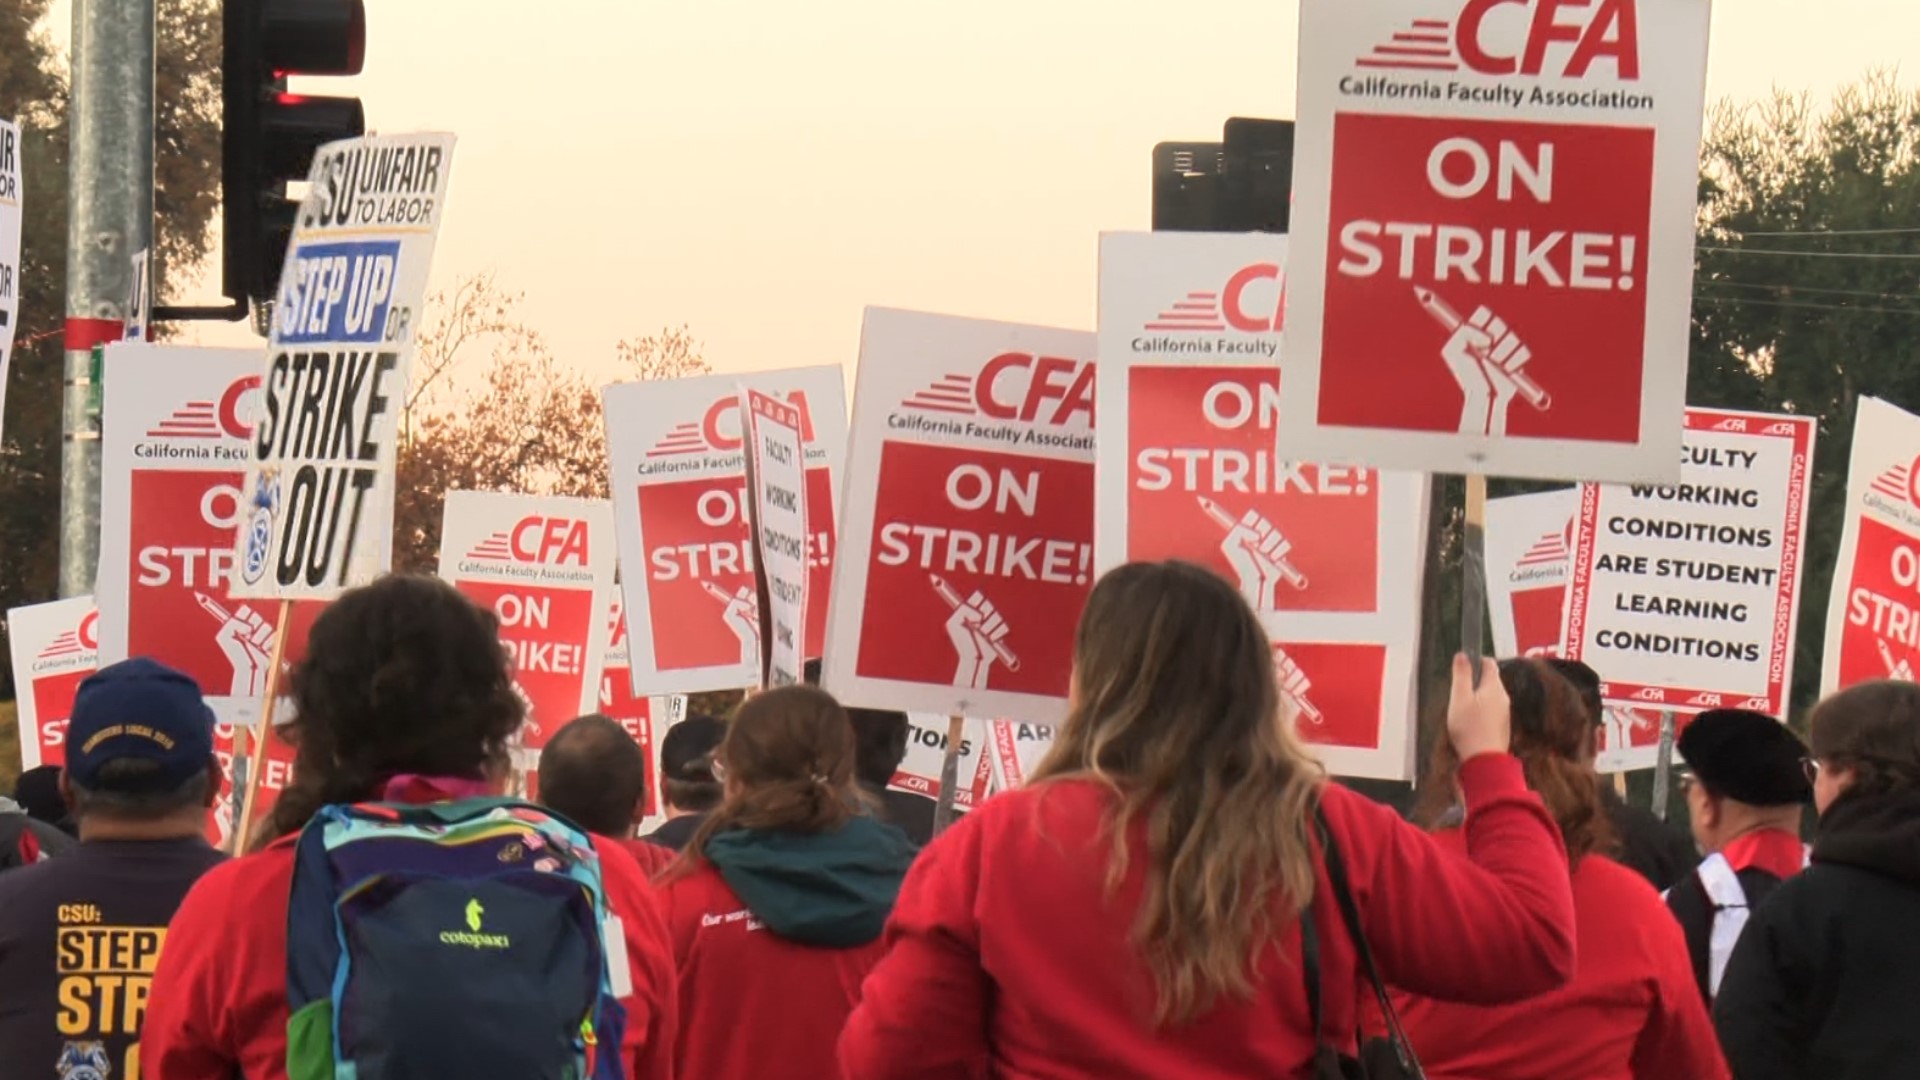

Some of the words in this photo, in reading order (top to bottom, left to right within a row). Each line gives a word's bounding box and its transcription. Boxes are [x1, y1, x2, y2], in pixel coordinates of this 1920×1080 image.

[1455, 0, 1640, 81] CFA
[1339, 76, 1441, 99] California
[1447, 82, 1524, 108] Faculty
[1529, 86, 1655, 110] Association
[360, 145, 443, 194] UNFAIR
[1426, 136, 1555, 204] ON
[354, 199, 376, 224] TO
[377, 198, 434, 225] LABOR
[1337, 219, 1637, 292] STRIKE!
[282, 255, 348, 336] STEP
[344, 254, 394, 335] UP
[1131, 337, 1212, 354] California
[1217, 339, 1277, 358] Faculty
[257, 351, 398, 462] STRIKE
[975, 352, 1097, 429] CFA
[888, 413, 962, 435] California
[965, 422, 1022, 444] Faculty
[1024, 428, 1096, 451] Associati
[1722, 418, 1747, 432] CFA
[1772, 423, 1796, 436] CFA
[134, 443, 209, 459] California
[214, 446, 249, 460] Facu
[637, 458, 700, 476] California
[703, 455, 746, 470] Facult
[1681, 445, 1758, 469] CULTY
[945, 463, 1040, 516] ON
[1630, 483, 1760, 508] WORKING
[1786, 453, 1805, 533] CALIFORNIA
[276, 464, 377, 588] OUT
[511, 515, 589, 567] CFA
[1608, 516, 1773, 548] CONDITIONS
[878, 521, 1091, 586] STRIKE!
[1575, 525, 1591, 584] FACULTY
[1595, 554, 1649, 574] ARE
[1655, 558, 1777, 586] STUDENT
[1780, 534, 1797, 593] FACULTY
[458, 561, 502, 575] California
[505, 565, 538, 579] Faculty
[540, 568, 594, 582] Association
[496, 593, 550, 629] ON
[1568, 586, 1585, 661] CALIFORNIA
[1615, 593, 1748, 623] LEARNING
[1595, 630, 1760, 662] CONDITIONS
[1770, 595, 1790, 683] ASSOCIATION
[1641, 688, 1665, 701] CFA
[1698, 692, 1722, 706] CFA
[1747, 697, 1771, 710] CFA
[908, 776, 930, 791] CFA
[58, 904, 103, 922] CSU:
[60, 930, 158, 970] STEP
[440, 931, 510, 949] cotopaxi
[57, 976, 152, 1035] STR
